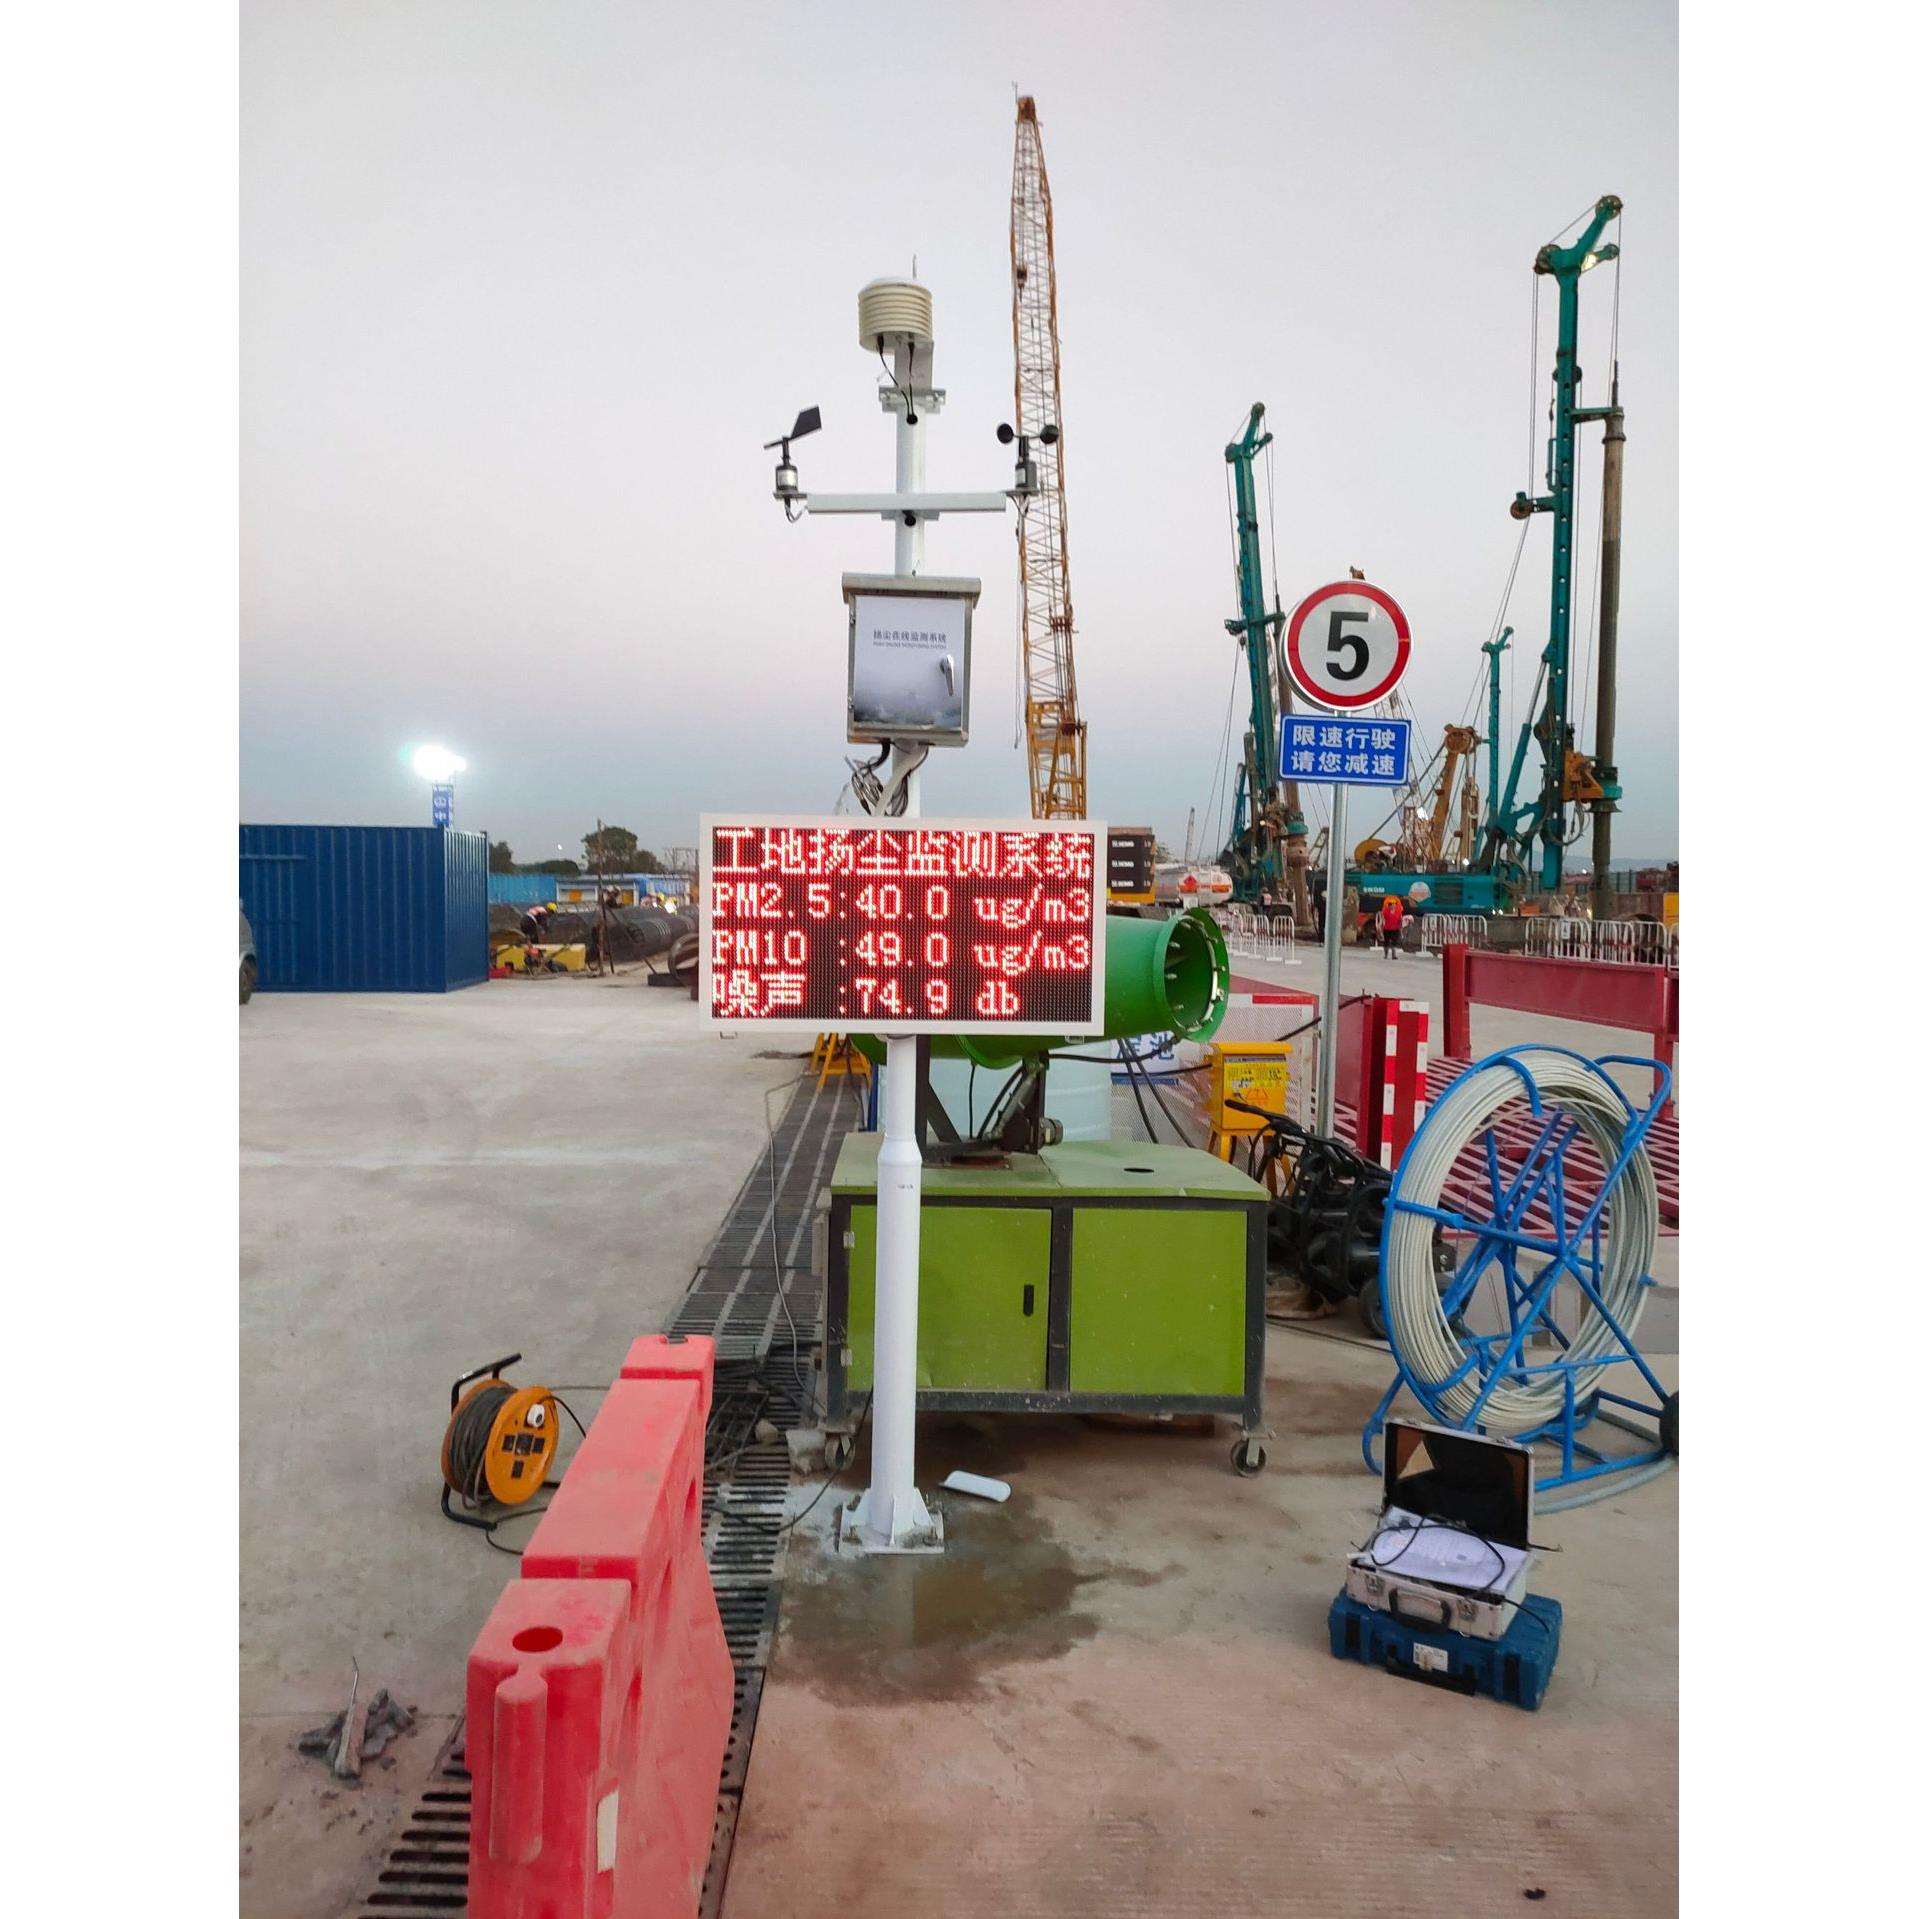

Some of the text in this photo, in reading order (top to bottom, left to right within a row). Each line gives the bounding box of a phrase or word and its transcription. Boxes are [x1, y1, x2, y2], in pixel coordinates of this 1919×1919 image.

[1326, 611, 1370, 681] 5
[1292, 724, 1396, 750] 限速行驶
[1290, 750, 1395, 776] 请您减速
[712, 827, 1092, 879] 工地扬尘监测系统
[972, 883, 1090, 929] ug/m3
[711, 929, 807, 966] PM10
[972, 930, 1090, 977] ug/m3
[711, 969, 807, 1017] 噪声
[976, 980, 1020, 1016] db
